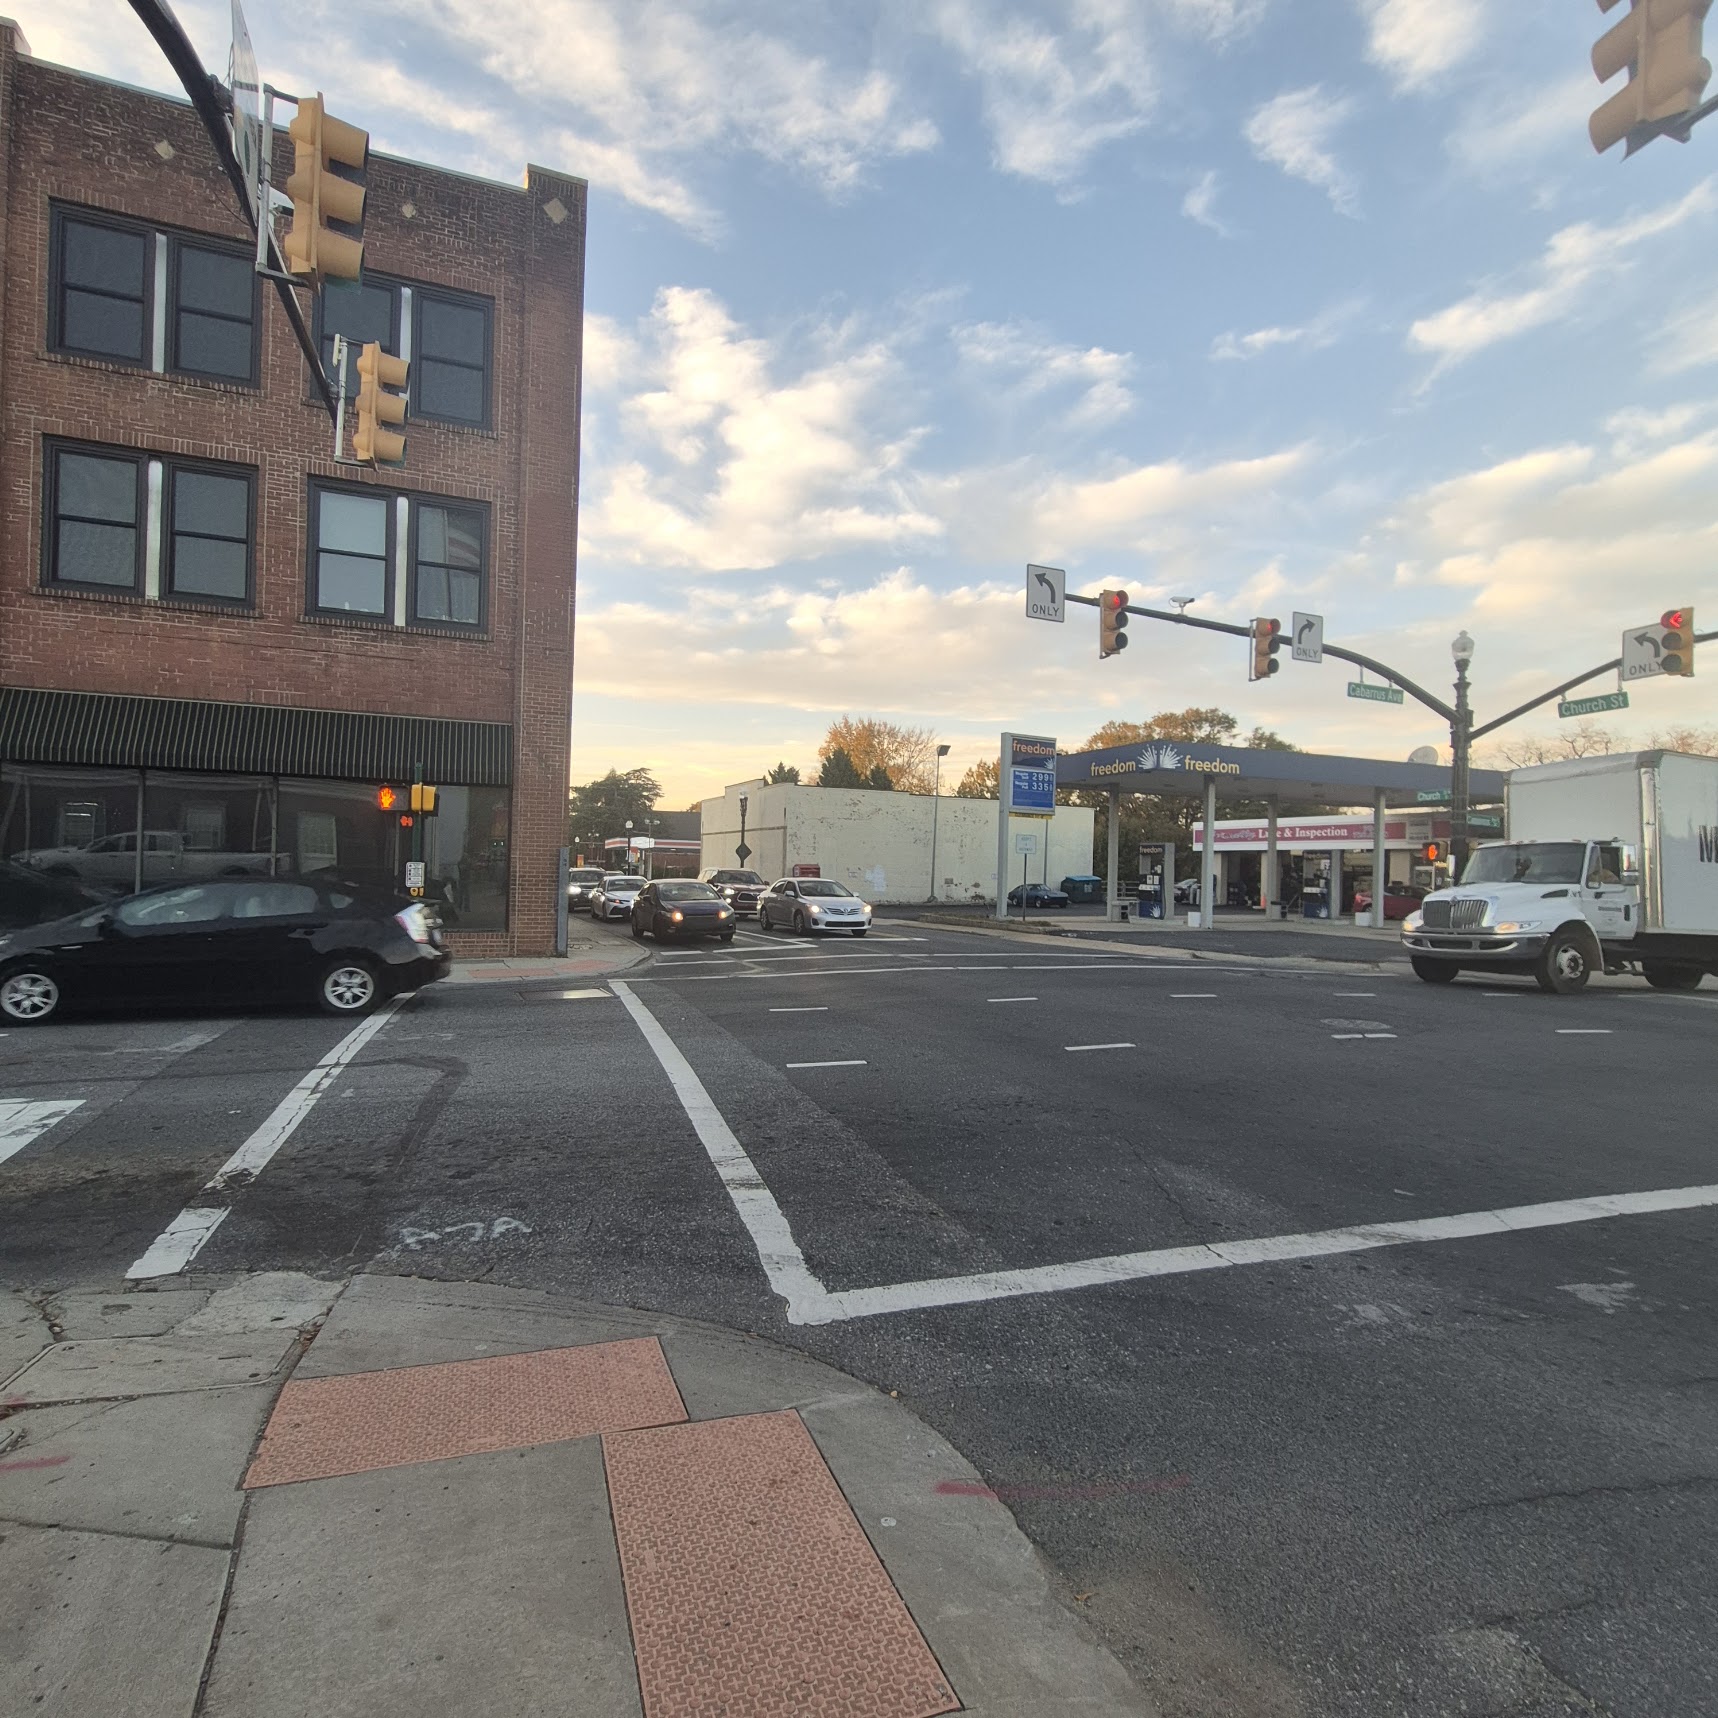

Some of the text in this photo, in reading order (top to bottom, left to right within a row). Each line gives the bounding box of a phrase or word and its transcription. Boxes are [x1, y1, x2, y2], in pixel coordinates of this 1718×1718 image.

[1032, 603, 1060, 617] ONLY
[1296, 647, 1319, 659] ONLY
[1350, 684, 1402, 702] Cabarrus Ave
[1561, 694, 1625, 716] Church St
[1012, 740, 1055, 756] freedom
[1091, 759, 1136, 776] freedom
[1184, 755, 1240, 774] freedom
[1258, 829, 1282, 839] Le
[1283, 828, 1293, 837] &
[1295, 826, 1348, 838] Inspection
[1139, 846, 1163, 854] freedom
